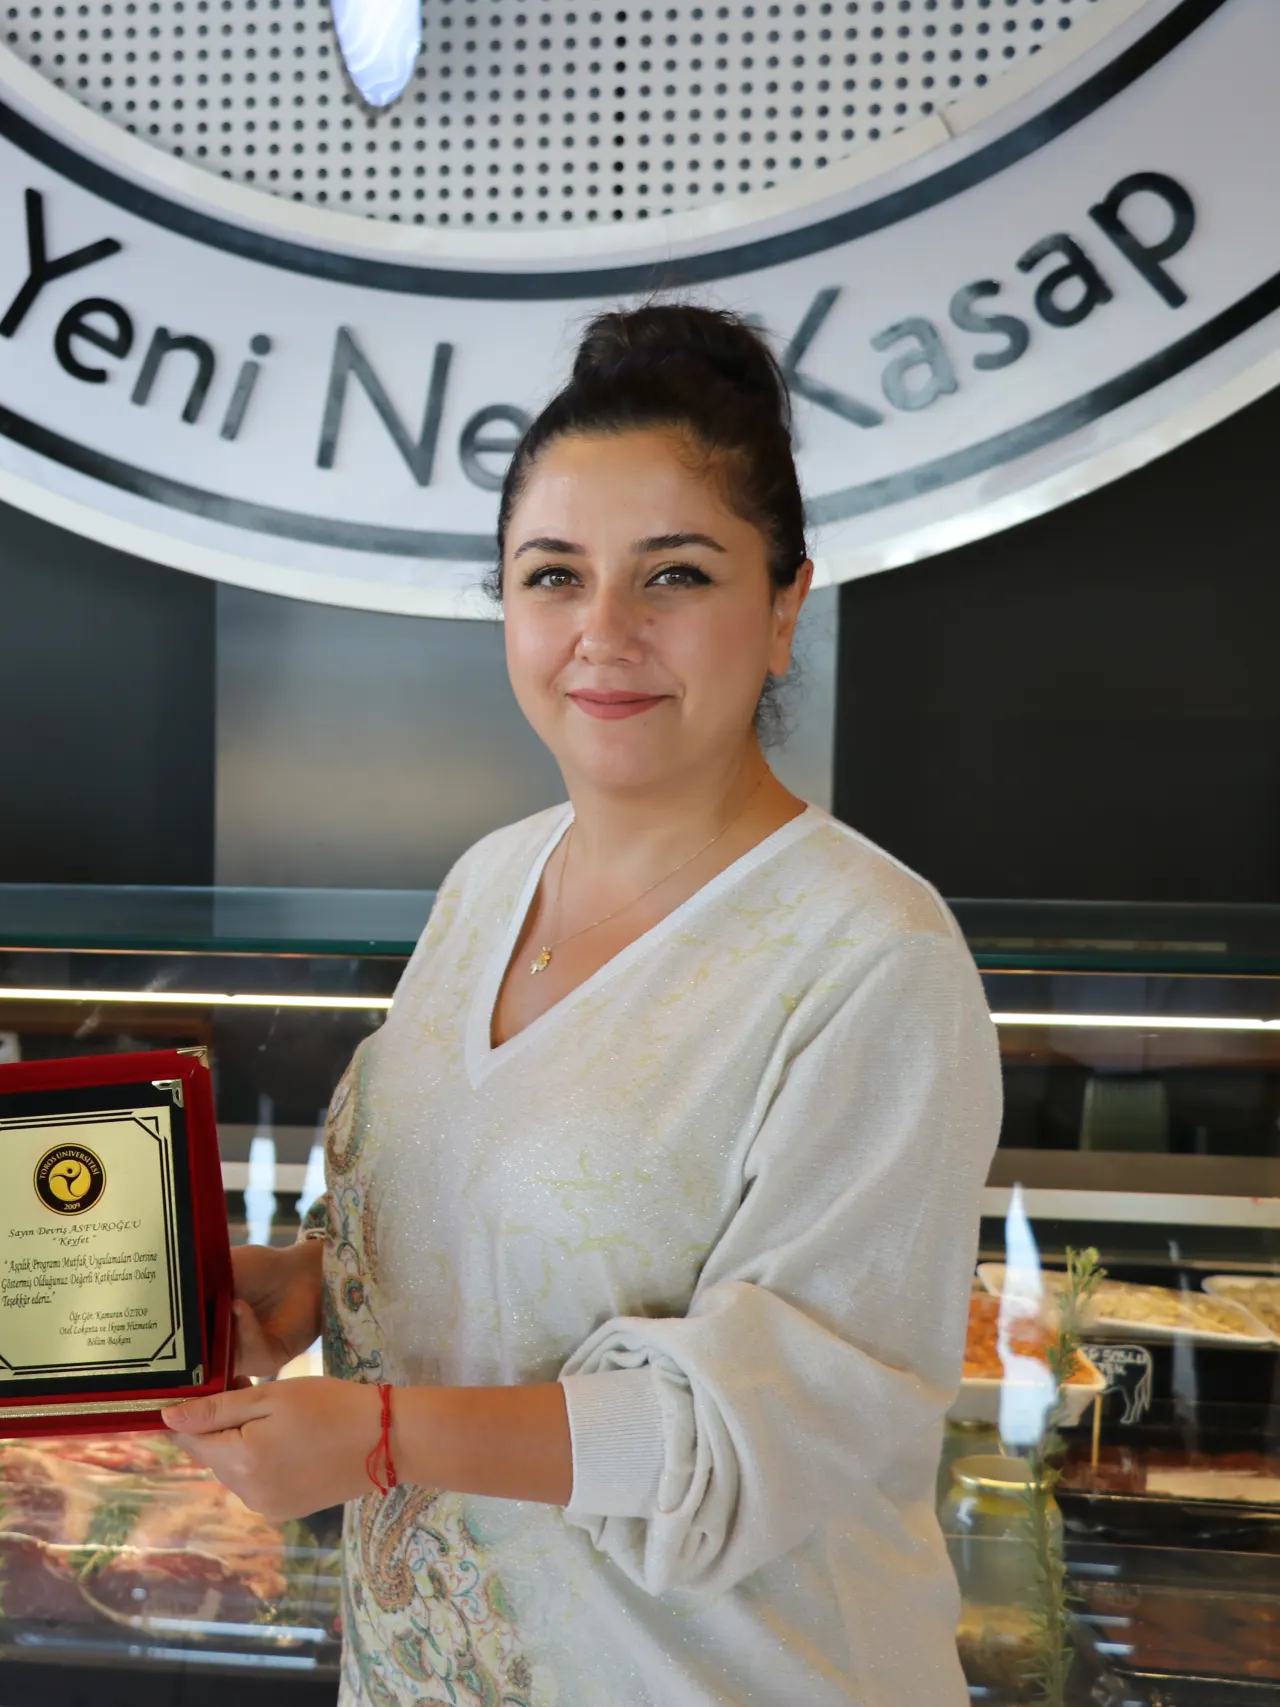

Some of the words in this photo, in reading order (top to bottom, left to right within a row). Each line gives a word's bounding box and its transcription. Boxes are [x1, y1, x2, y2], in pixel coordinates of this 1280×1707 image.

[746, 171, 1197, 444] Kasap
[39, 1154, 58, 1180] TOROS
[63, 1202, 81, 1211] 2009
[8, 1228, 35, 1239] Sayın
[38, 1225, 68, 1236] Devriş
[69, 1219, 142, 1234] ASFUROĞLU
[62, 1254, 88, 1271] Mutfak
[88, 1252, 132, 1269] Uygulamaları
[133, 1250, 157, 1263] Dersine
[1, 1278, 32, 1293] Göstermiş
[33, 1274, 69, 1290] Olduğunuz
[70, 1271, 93, 1288] Değerli
[94, 1268, 133, 1286] Katkılardan
[134, 1267, 157, 1284] Dolayı
[2, 1293, 30, 1309] Teşekkür
[96, 1310, 123, 1321] Kamuran
[124, 1307, 149, 1318] ÖZTOP
[58, 1325, 73, 1336] Otel
[73, 1323, 98, 1335] Lokanta
[126, 1319, 158, 1331] Hizmetleri
[87, 1336, 106, 1347] Bölüm
